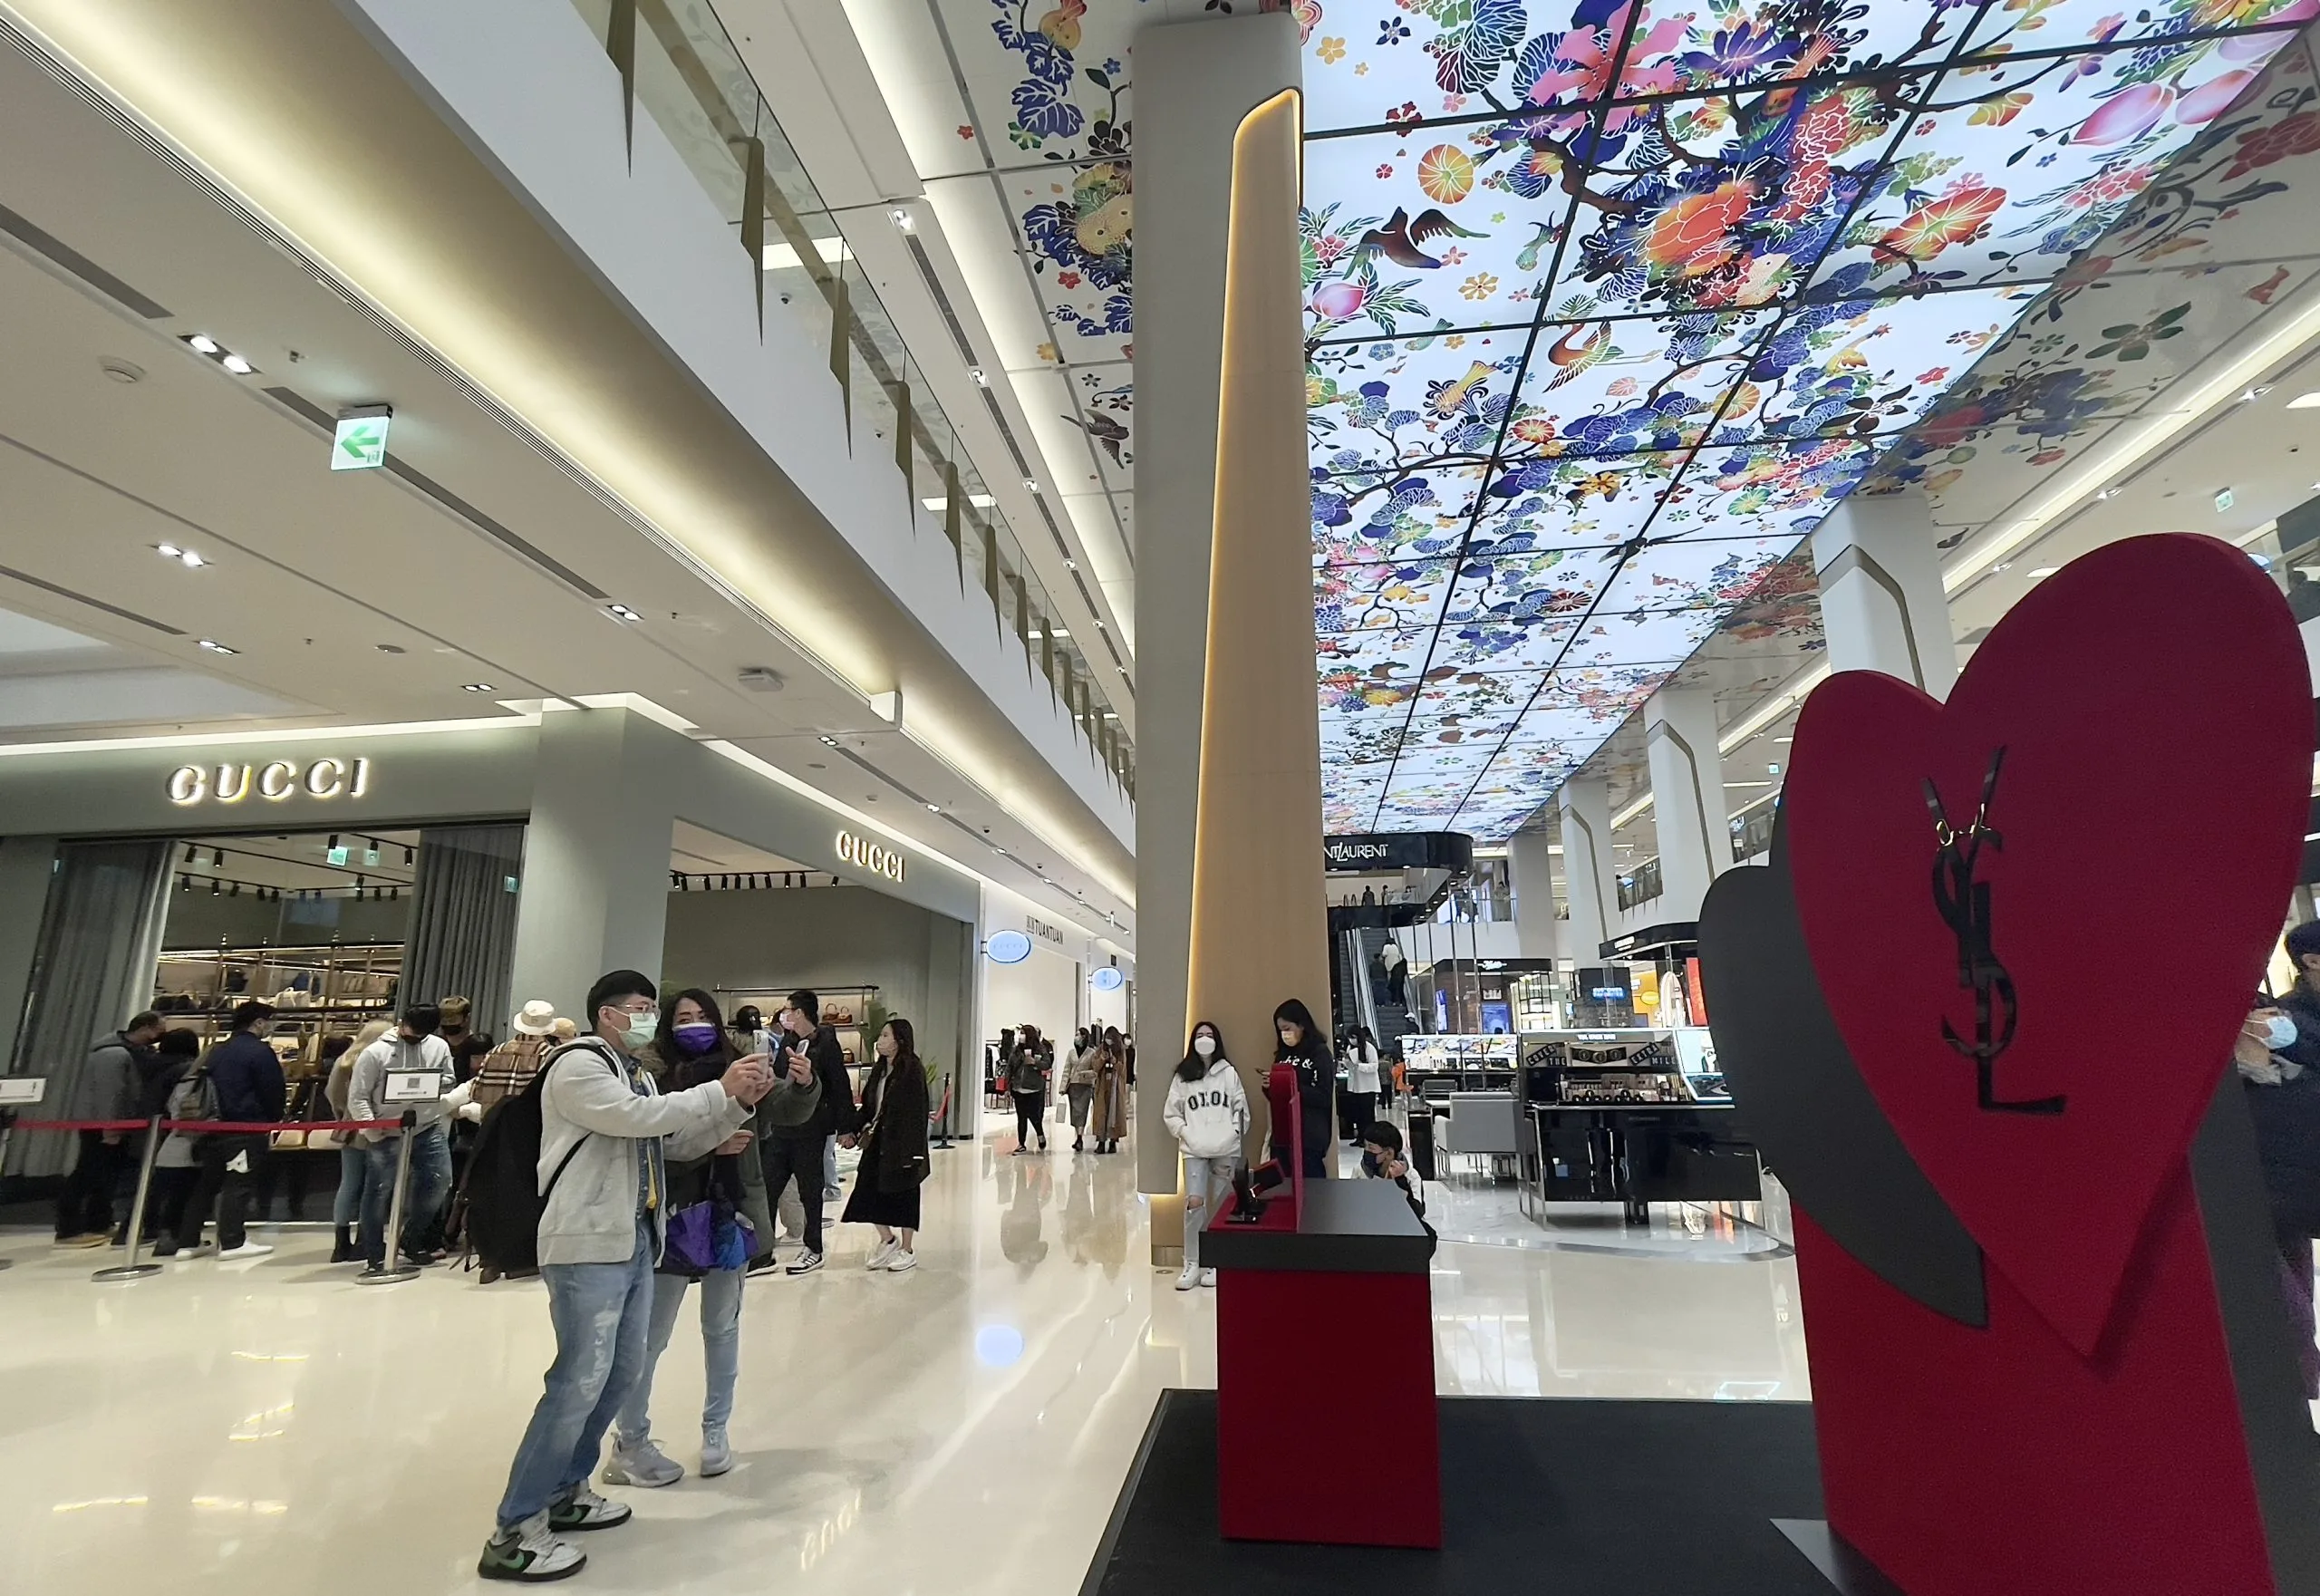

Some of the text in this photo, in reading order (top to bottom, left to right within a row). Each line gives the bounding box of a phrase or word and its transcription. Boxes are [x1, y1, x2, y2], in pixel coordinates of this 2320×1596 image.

[165, 757, 369, 805] GUCCI
[835, 829, 904, 883] GUCCI
[1920, 745, 2068, 1116] YSL
